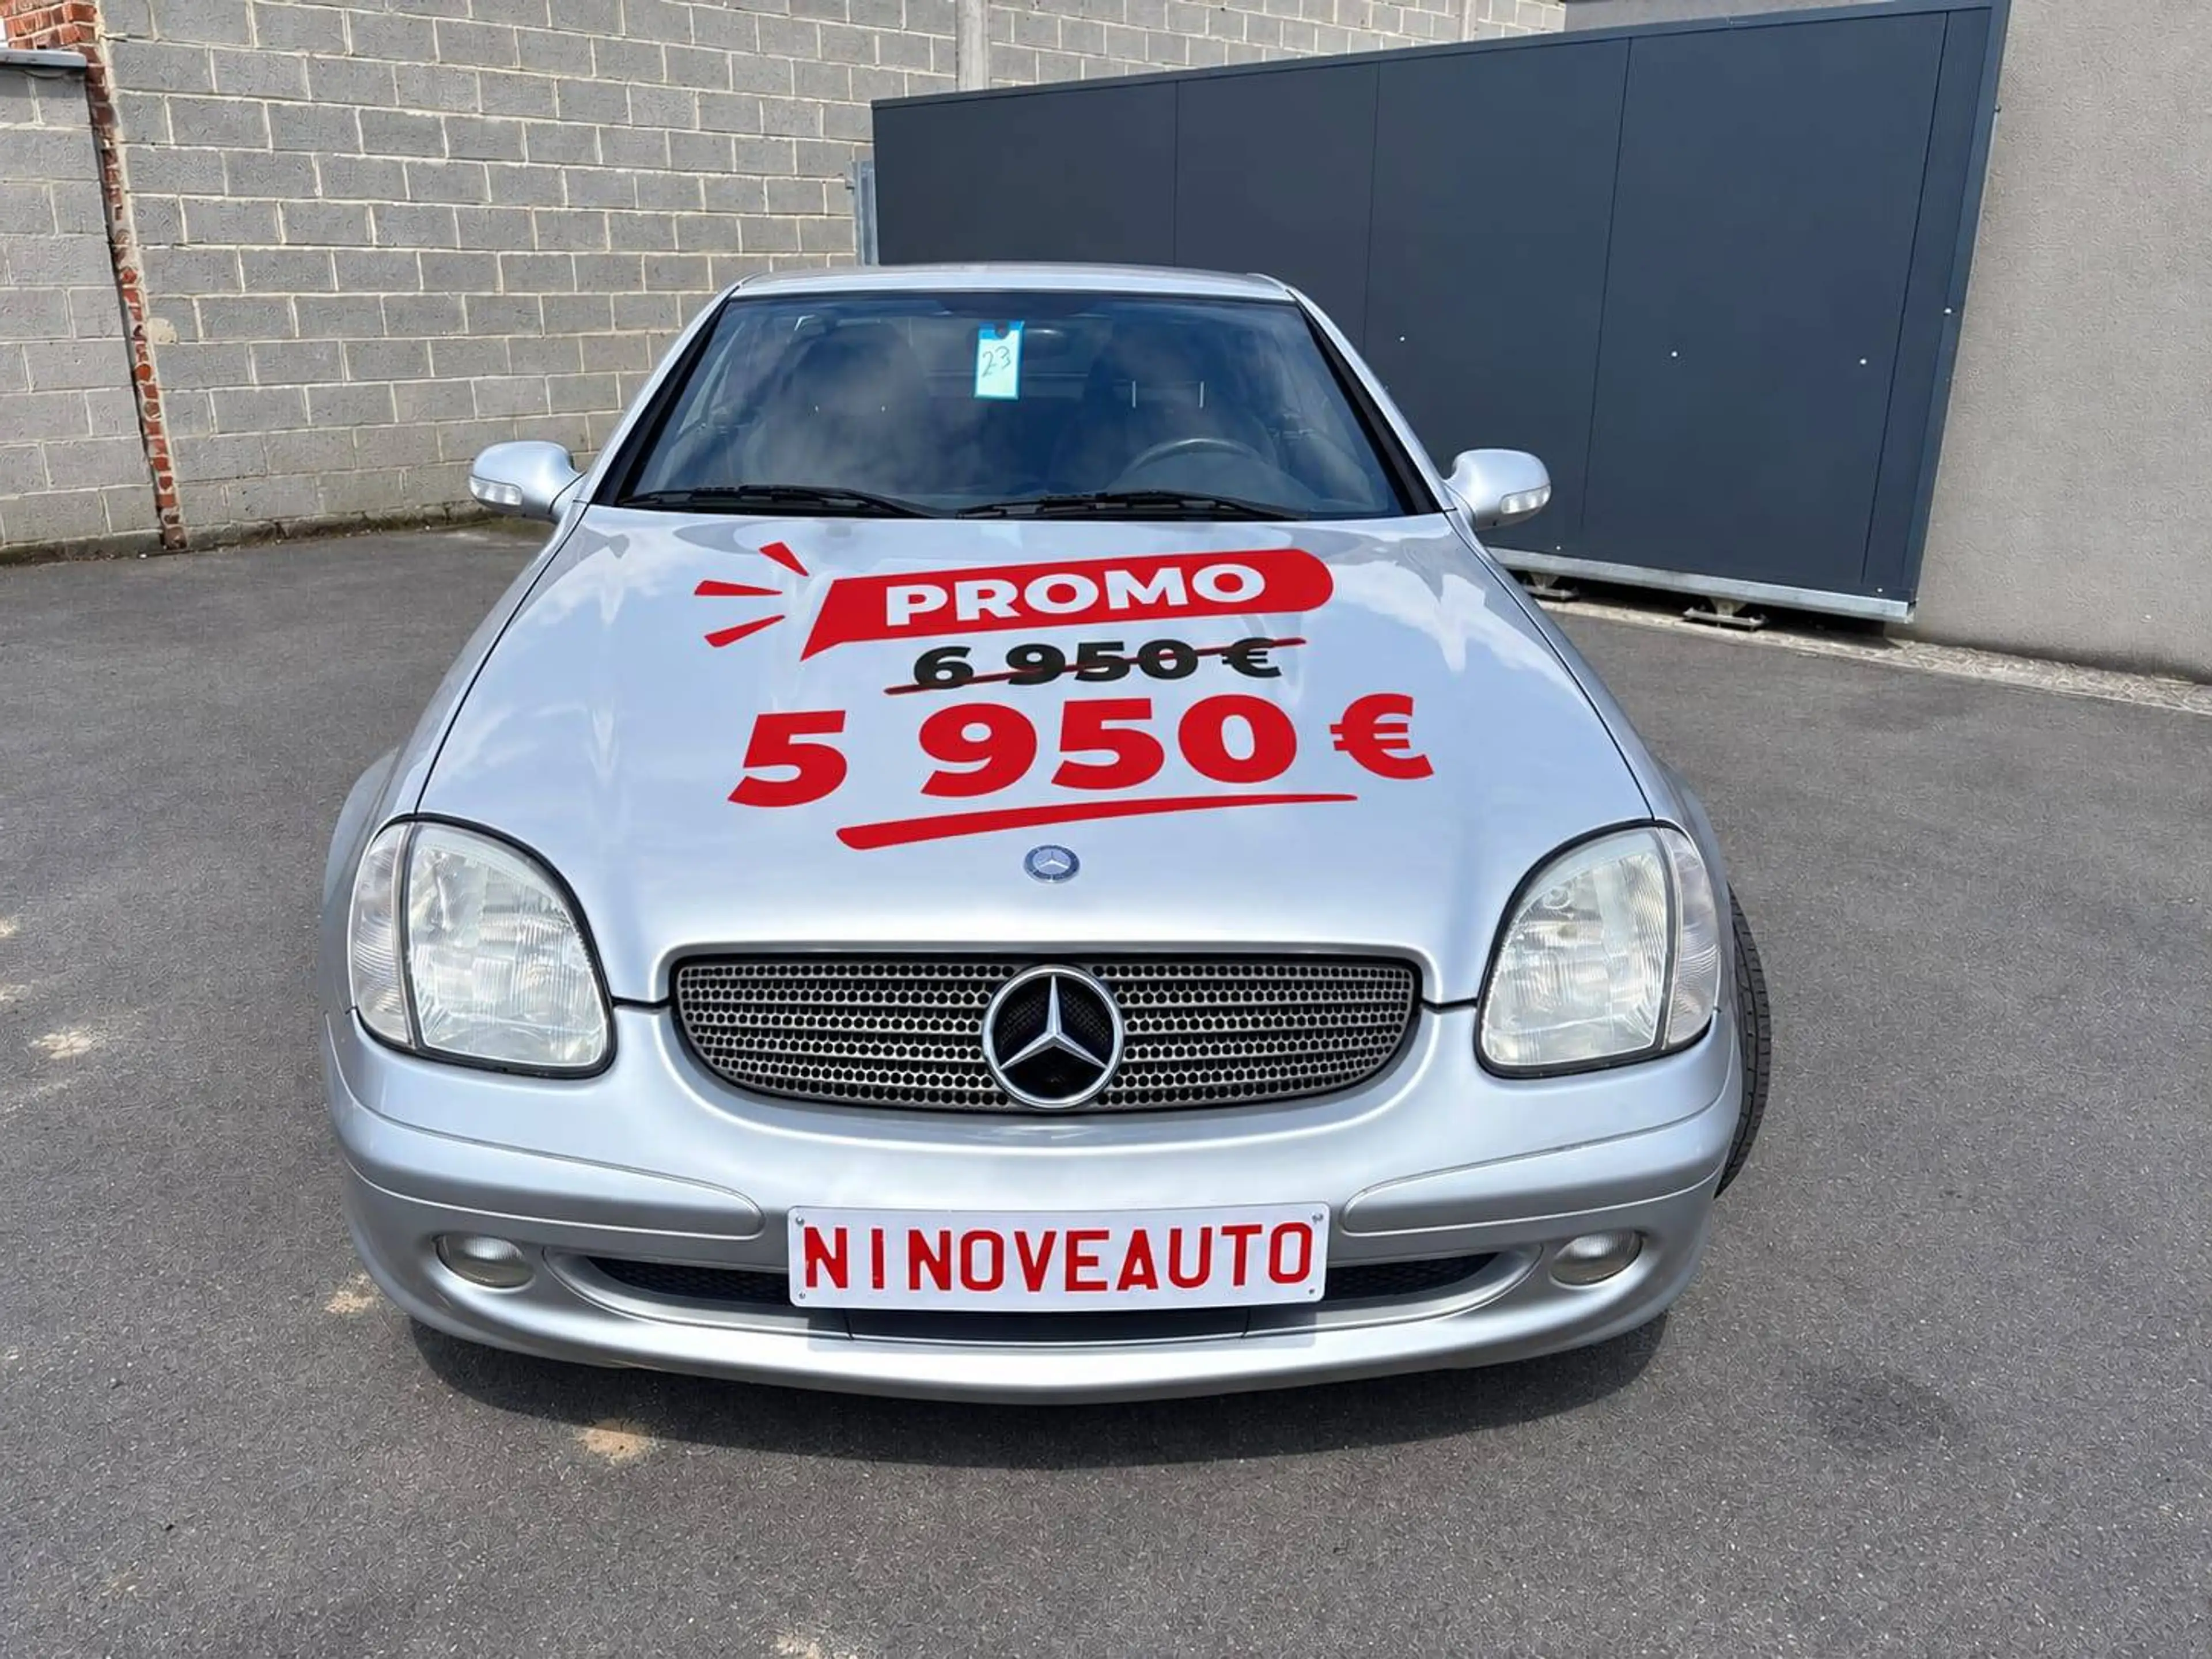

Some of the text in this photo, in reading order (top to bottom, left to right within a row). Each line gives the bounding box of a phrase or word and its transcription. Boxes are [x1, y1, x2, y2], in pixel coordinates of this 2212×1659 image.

[982, 345, 1011, 378] 23
[885, 563, 1266, 627] PROMO
[914, 637, 1282, 690] 6 950 €
[728, 693, 1434, 808] 5 950 €
[803, 1221, 1313, 1293] NINOVEAUTO
